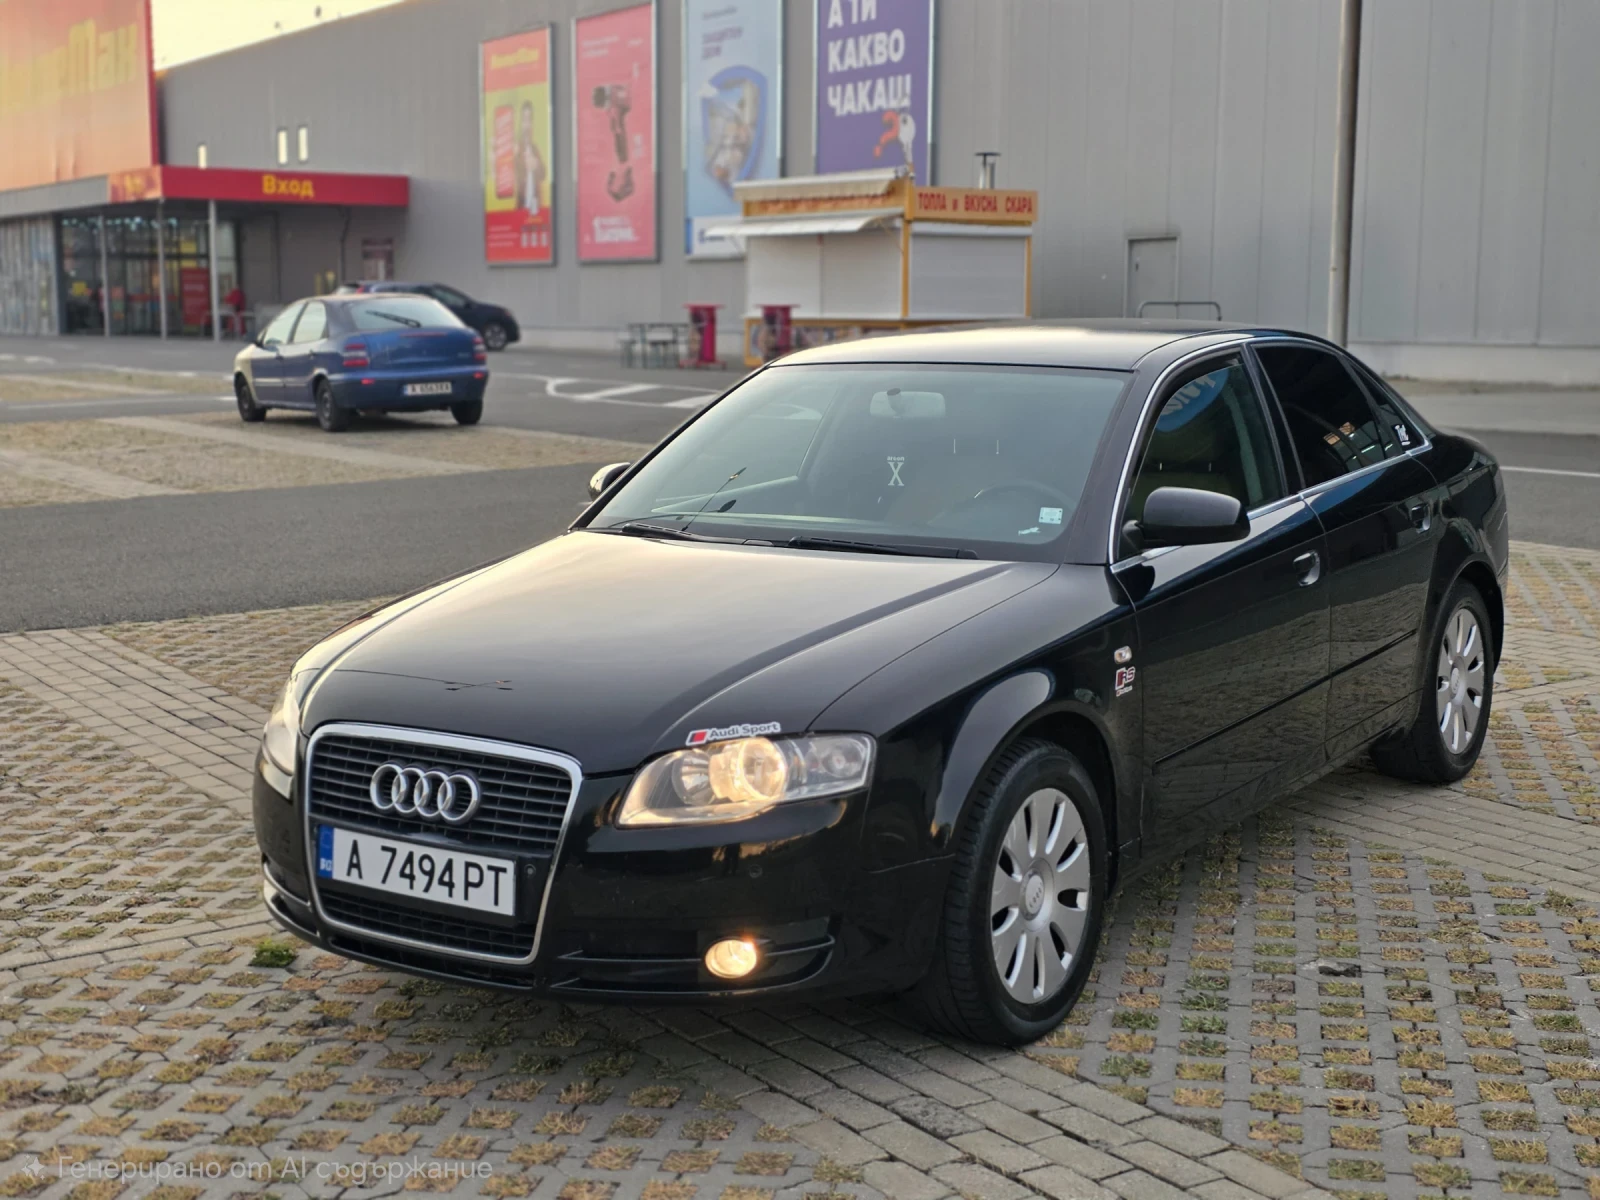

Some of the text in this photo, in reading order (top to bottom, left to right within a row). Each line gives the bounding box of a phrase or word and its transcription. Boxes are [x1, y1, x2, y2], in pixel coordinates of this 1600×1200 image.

[827, 0, 844, 28] А
[828, 28, 905, 73] КАКВО
[262, 174, 315, 199] Вход
[964, 193, 998, 212] ВКУСНА
[1006, 195, 1033, 214] СКАРА
[888, 461, 905, 486] X
[710, 723, 778, 738] Audi Sport
[346, 839, 507, 906] A 7494PT
